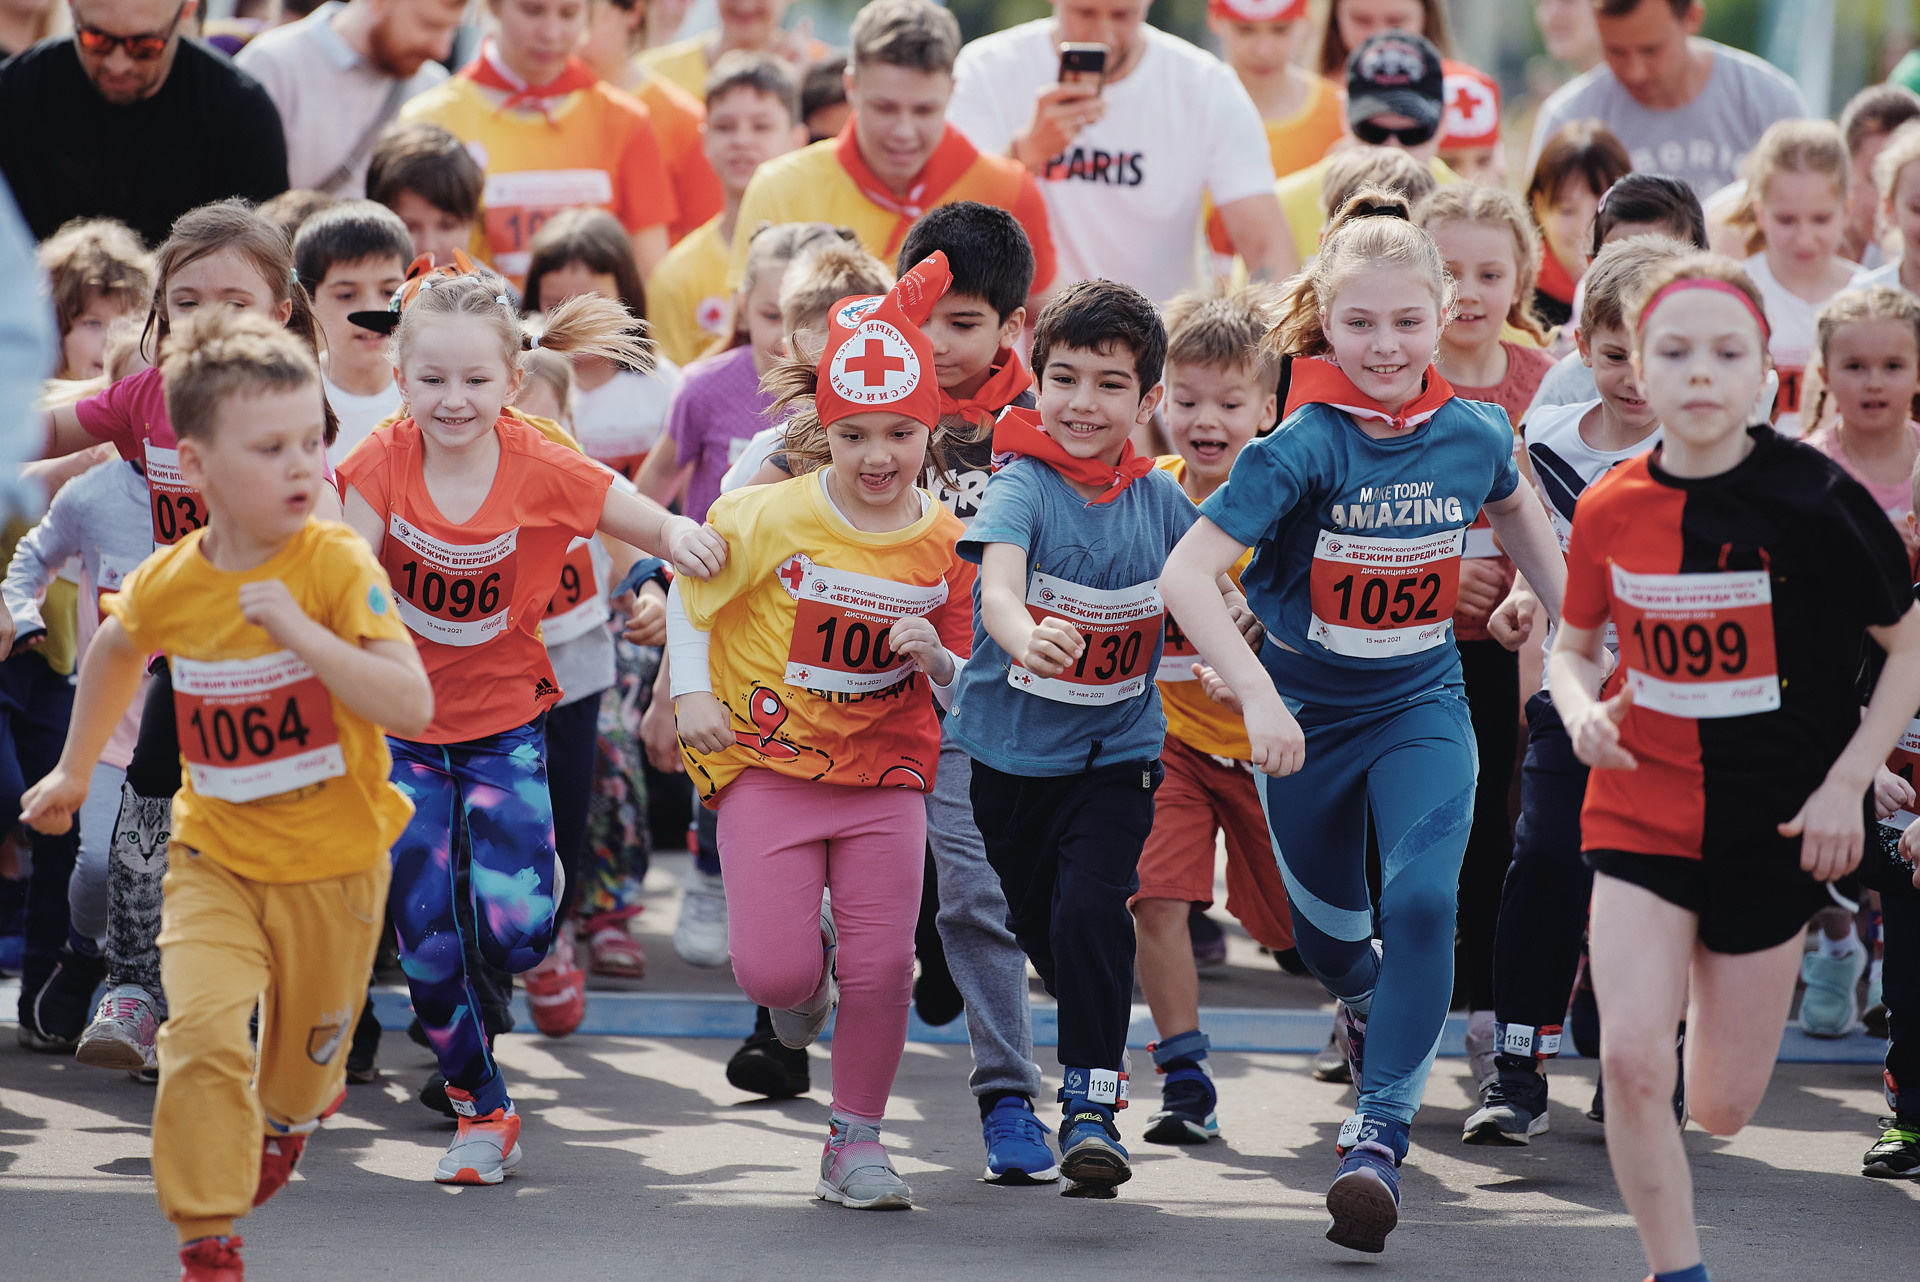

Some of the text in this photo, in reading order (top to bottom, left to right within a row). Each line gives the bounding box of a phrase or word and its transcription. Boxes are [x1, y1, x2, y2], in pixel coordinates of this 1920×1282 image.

[866, 323, 915, 361] КРАСНЫЙ
[832, 372, 917, 403] РОССИЙСКИЙ
[1360, 481, 1434, 503] MAKE TODAY
[157, 494, 209, 540] 03
[1331, 496, 1464, 529] AMAZING
[411, 540, 510, 566] «БЕЖИМ ВПЕРЕДИ ЧС»
[413, 533, 427, 547] ЗАБЕГ
[428, 541, 468, 557] РОССИЙСКОГО
[469, 547, 496, 557] КРАСНОГО
[1345, 551, 1393, 563] «БЕЖИМ
[1395, 551, 1437, 563] ВПЕРЕДИ
[1438, 546, 1454, 555] ЧС»
[1368, 544, 1411, 553] РОССИЙСКОГО
[1412, 541, 1436, 552] КРАСНОГО
[1437, 538, 1455, 546] КРЕСТА
[422, 559, 463, 576] ДИСТАНЦИЯ
[1361, 567, 1406, 576] ДИСТАНЦИЯ
[402, 560, 501, 618] 1096
[833, 585, 851, 593] ЗАБЕГ
[852, 588, 895, 602] РОССИЙСКОГО
[895, 597, 926, 605] КРАСНОГО
[1333, 572, 1441, 625] 1052
[830, 593, 876, 609] «БЕЖИМ
[878, 602, 926, 616] ВПЕРЕДИ
[1057, 603, 1103, 619] «БЕЖИМ
[1105, 607, 1143, 620] ВПЕРЕДИ
[1144, 604, 1158, 614] ЧС»
[1060, 594, 1078, 605] ЗАБЕГ
[1079, 601, 1120, 611] РОССИЙСКОГО
[1120, 600, 1143, 610] КРАСНОГО
[844, 611, 889, 625] ДИСТАНЦИЯ
[1071, 621, 1114, 634] ДИСТАНЦИЯ
[1113, 625, 1125, 633] 500
[816, 616, 911, 669] 100
[1633, 619, 1748, 677] 1099
[1074, 630, 1142, 680] 130
[191, 696, 310, 762] 1064
[1506, 1034, 1530, 1048] 1138
[1090, 1080, 1115, 1093] 1130
[1074, 1112, 1103, 1122] FILA
[1342, 1122, 1360, 1135] 1052
